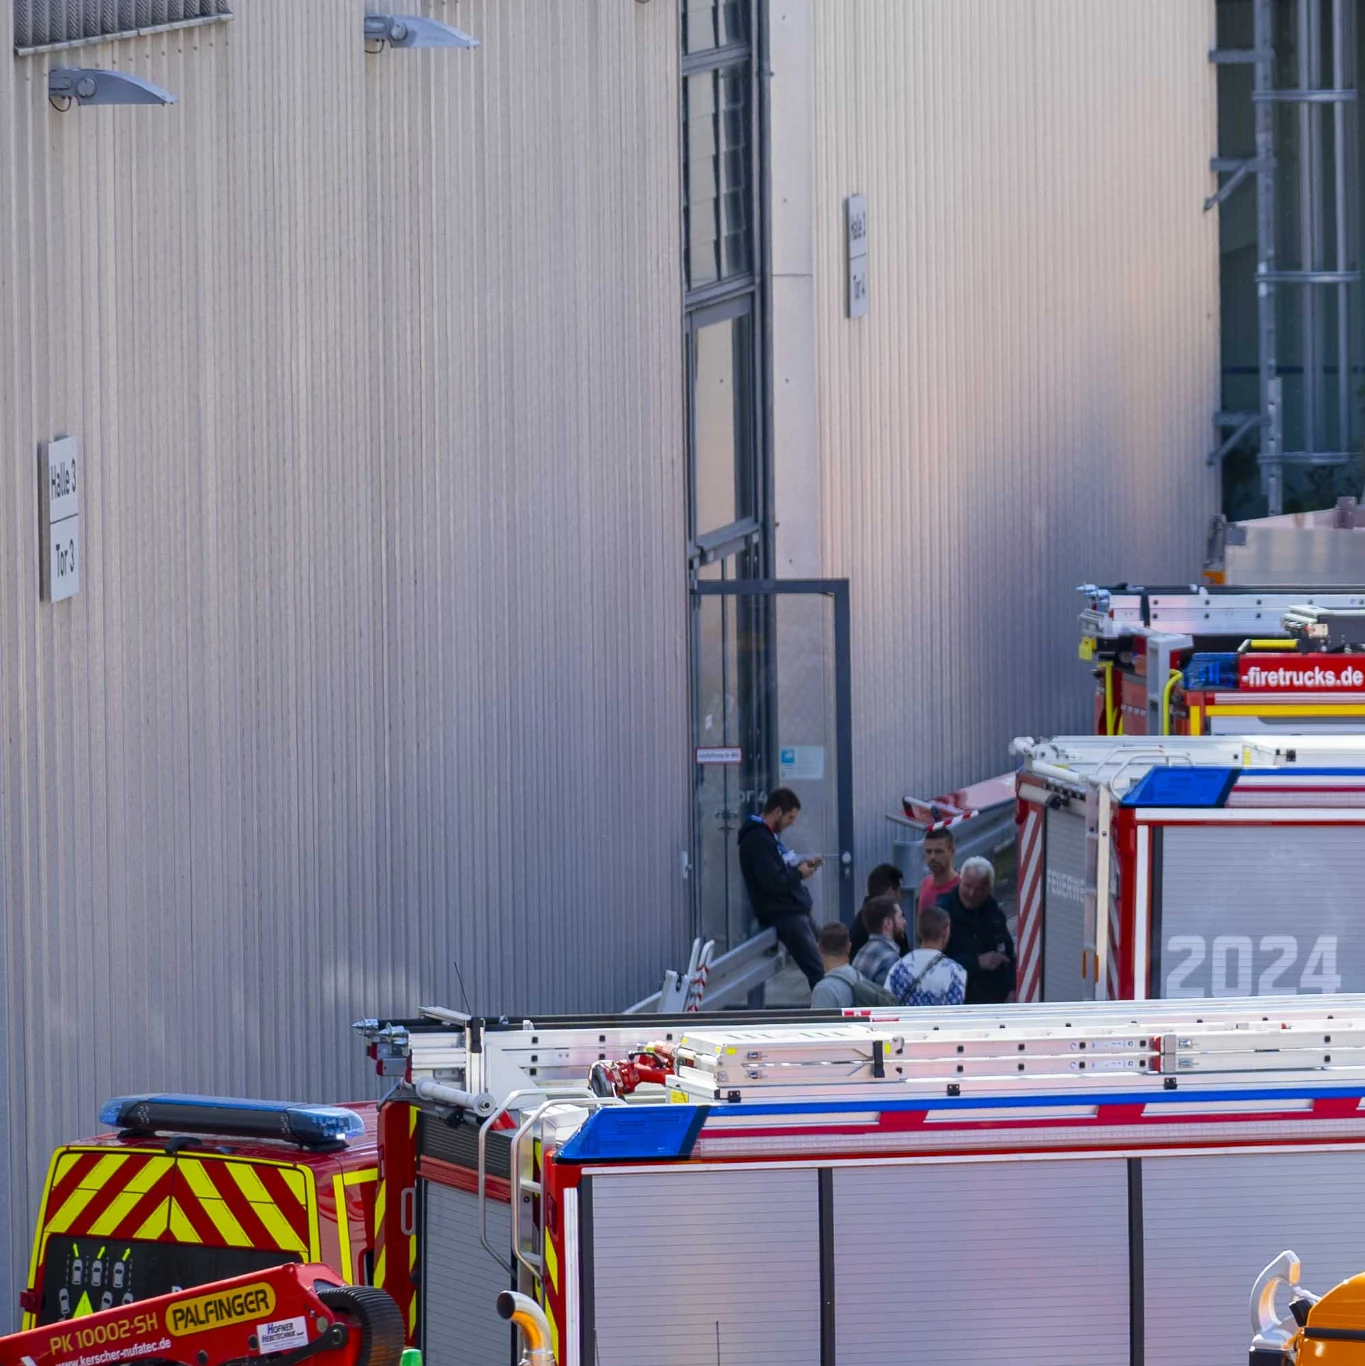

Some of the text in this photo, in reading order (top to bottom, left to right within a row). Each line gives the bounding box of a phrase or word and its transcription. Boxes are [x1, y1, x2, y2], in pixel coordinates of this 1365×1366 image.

[51, 456, 77, 500] Halle 3
[55, 538, 75, 578] Tor 3
[1166, 935, 1341, 999] 2024
[172, 1289, 270, 1331] PALFINGER
[50, 1312, 159, 1356] PK 10002-SH
